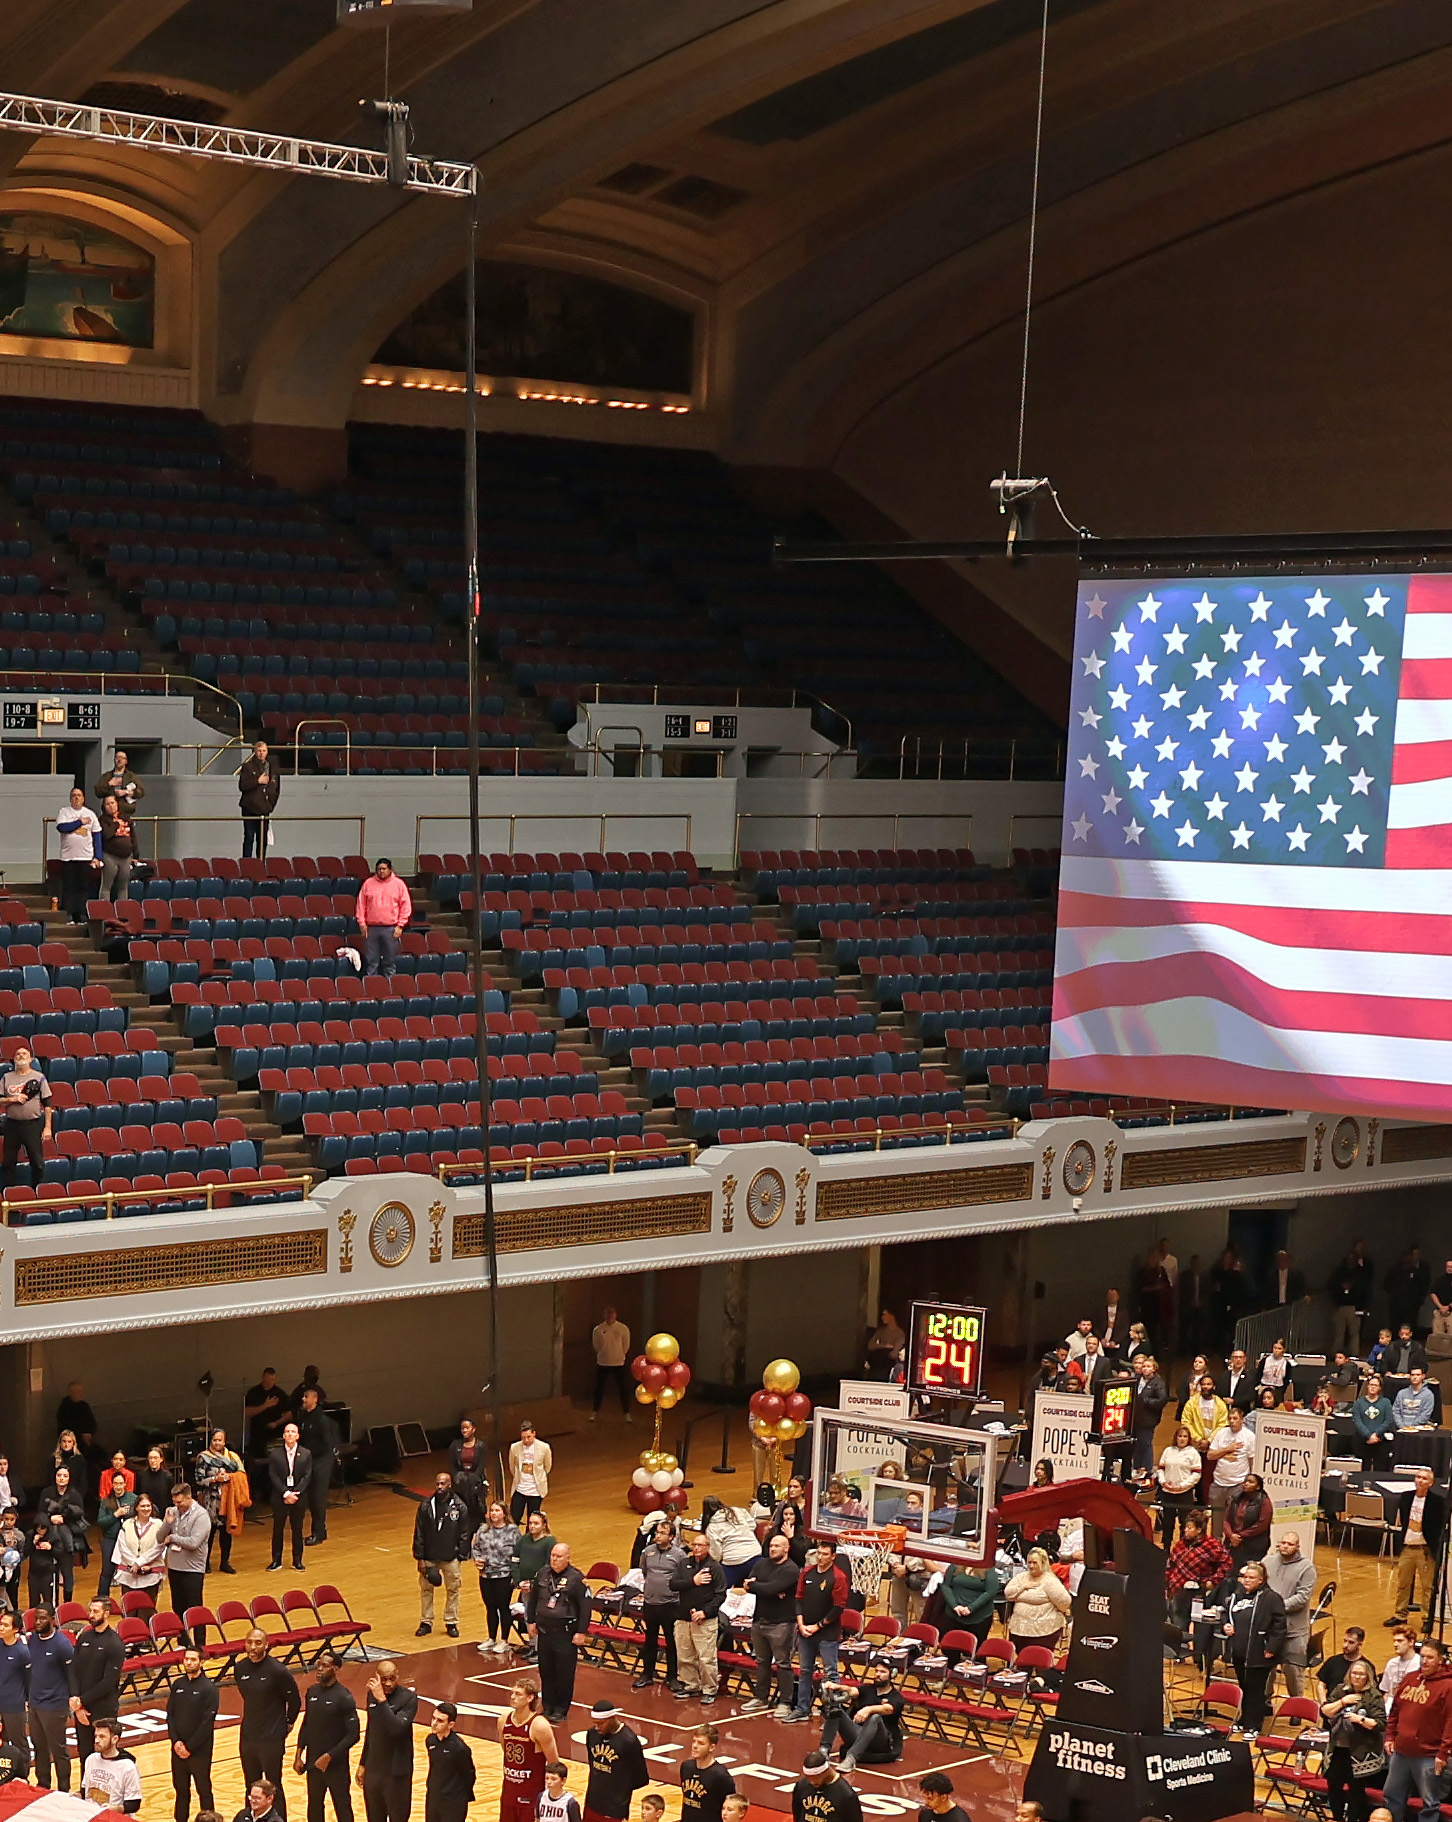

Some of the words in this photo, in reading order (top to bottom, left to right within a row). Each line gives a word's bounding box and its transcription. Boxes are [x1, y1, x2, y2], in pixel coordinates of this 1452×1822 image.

[12, 705, 30, 713] 10-8
[79, 705, 93, 714] 8-6
[11, 718, 25, 727] 9-7
[79, 718, 93, 727] 7-5
[928, 1314, 979, 1342] 12:00
[925, 1339, 971, 1384] 24
[848, 1396, 883, 1406] COURTSIDE
[884, 1398, 901, 1407] CLUB
[1043, 1408, 1078, 1417] COURTSIDE
[1105, 1408, 1124, 1431] 24
[1263, 1426, 1298, 1437] COURTSIDE
[1299, 1430, 1316, 1439] CLUB
[847, 1445, 895, 1456] COCKTAILS
[1263, 1445, 1310, 1478] POPE'S
[1089, 1594, 1110, 1605] SEAT
[1088, 1603, 1110, 1615] GEEK
[1400, 1684, 1430, 1704] CAVS
[1049, 1731, 1115, 1759] planet
[506, 1742, 525, 1765] 33
[1163, 1752, 1206, 1773] Cleveland
[1206, 1748, 1232, 1765] Clinic
[1056, 1749, 1127, 1780] fitness
[504, 1767, 532, 1779] OCKET
[1166, 1776, 1187, 1790] Sports
[1187, 1772, 1214, 1786] Medicine
[539, 1804, 564, 1819] OHIO
[802, 1797, 835, 1815] CHARGE
